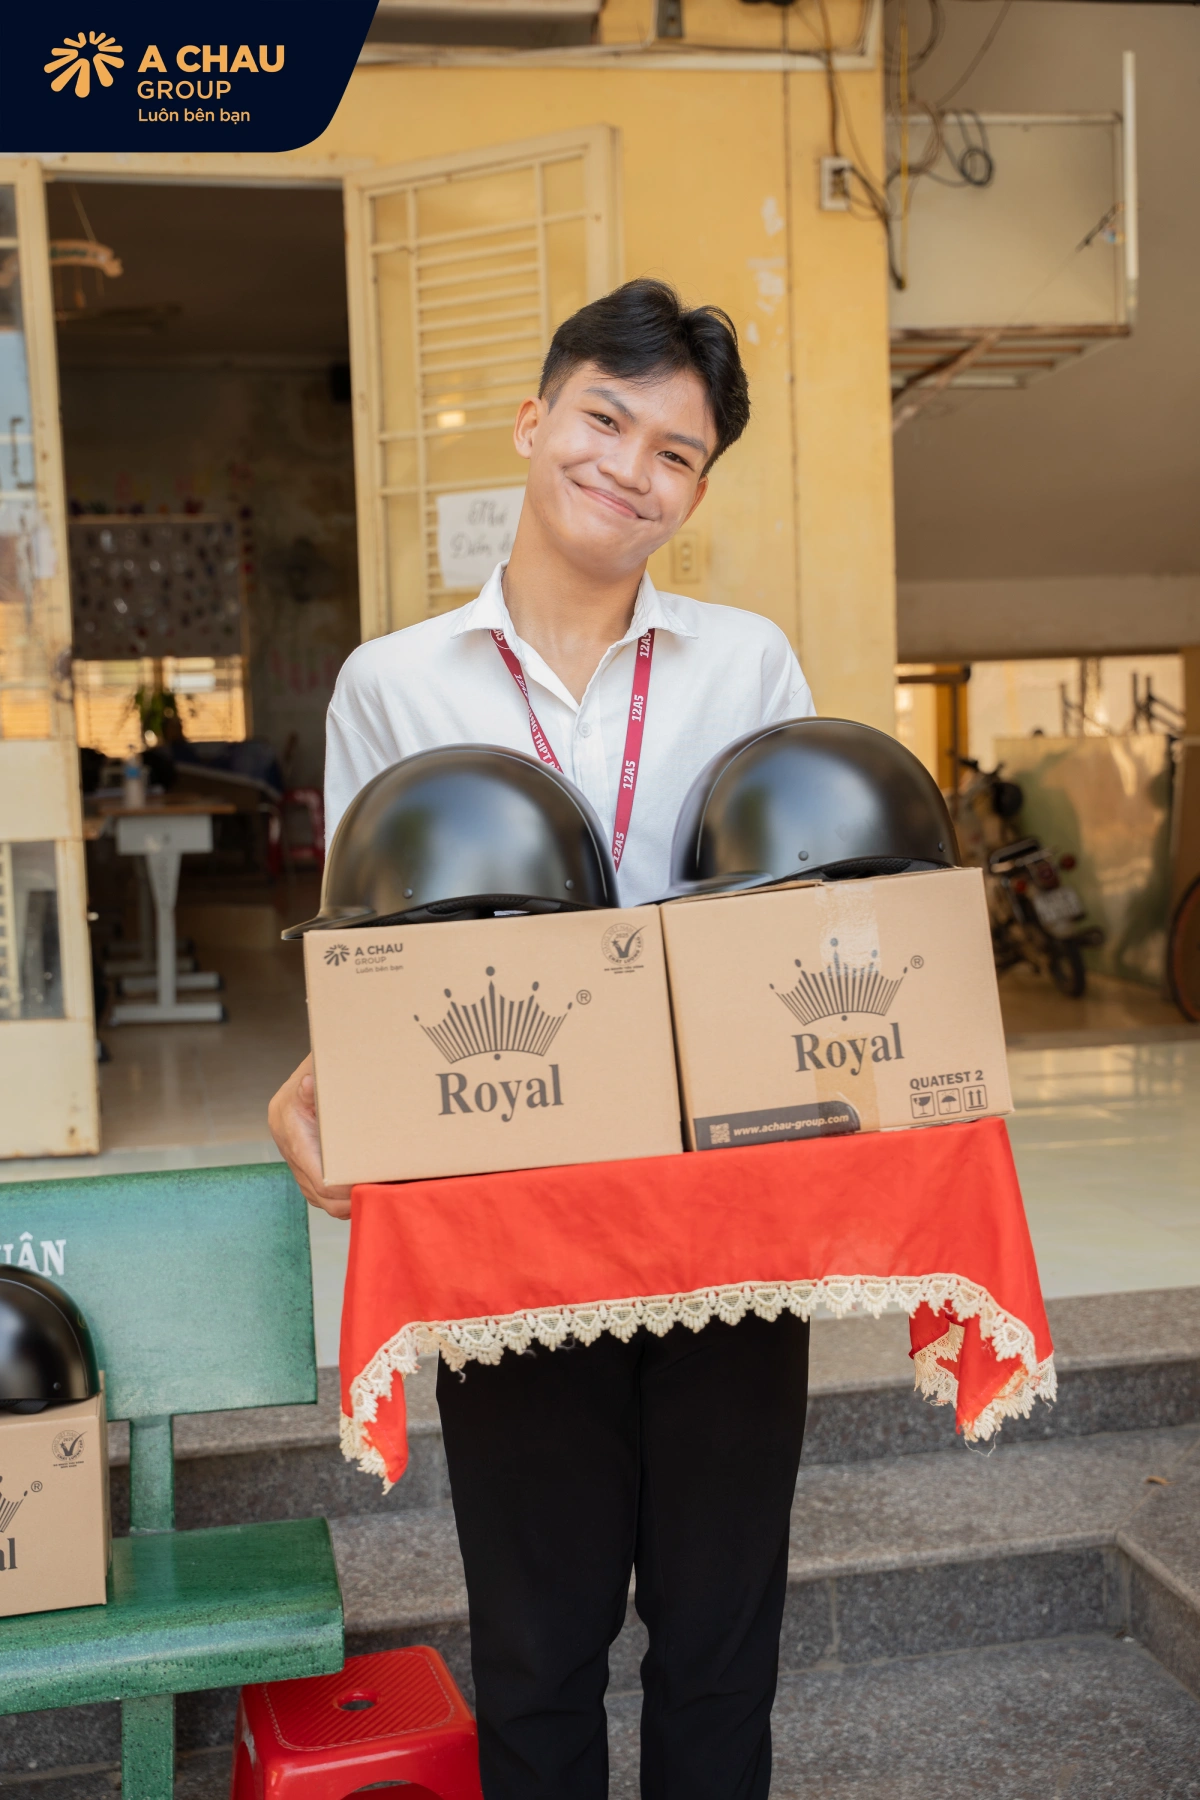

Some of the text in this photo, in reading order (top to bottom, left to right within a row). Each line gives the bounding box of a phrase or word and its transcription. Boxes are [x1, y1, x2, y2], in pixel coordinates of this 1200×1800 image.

[639, 632, 652, 658] 12A5
[631, 695, 644, 722] 12A5
[533, 731, 552, 764] THPT
[622, 760, 636, 790] 12A5
[612, 831, 625, 864] 12A5
[355, 943, 403, 956] A CHAU
[355, 956, 387, 966] GROUP
[791, 1022, 905, 1076] Royal
[435, 1064, 564, 1122] Royal
[910, 1070, 984, 1090] QUATEST 2
[733, 1114, 849, 1136] www.achau-group.com
